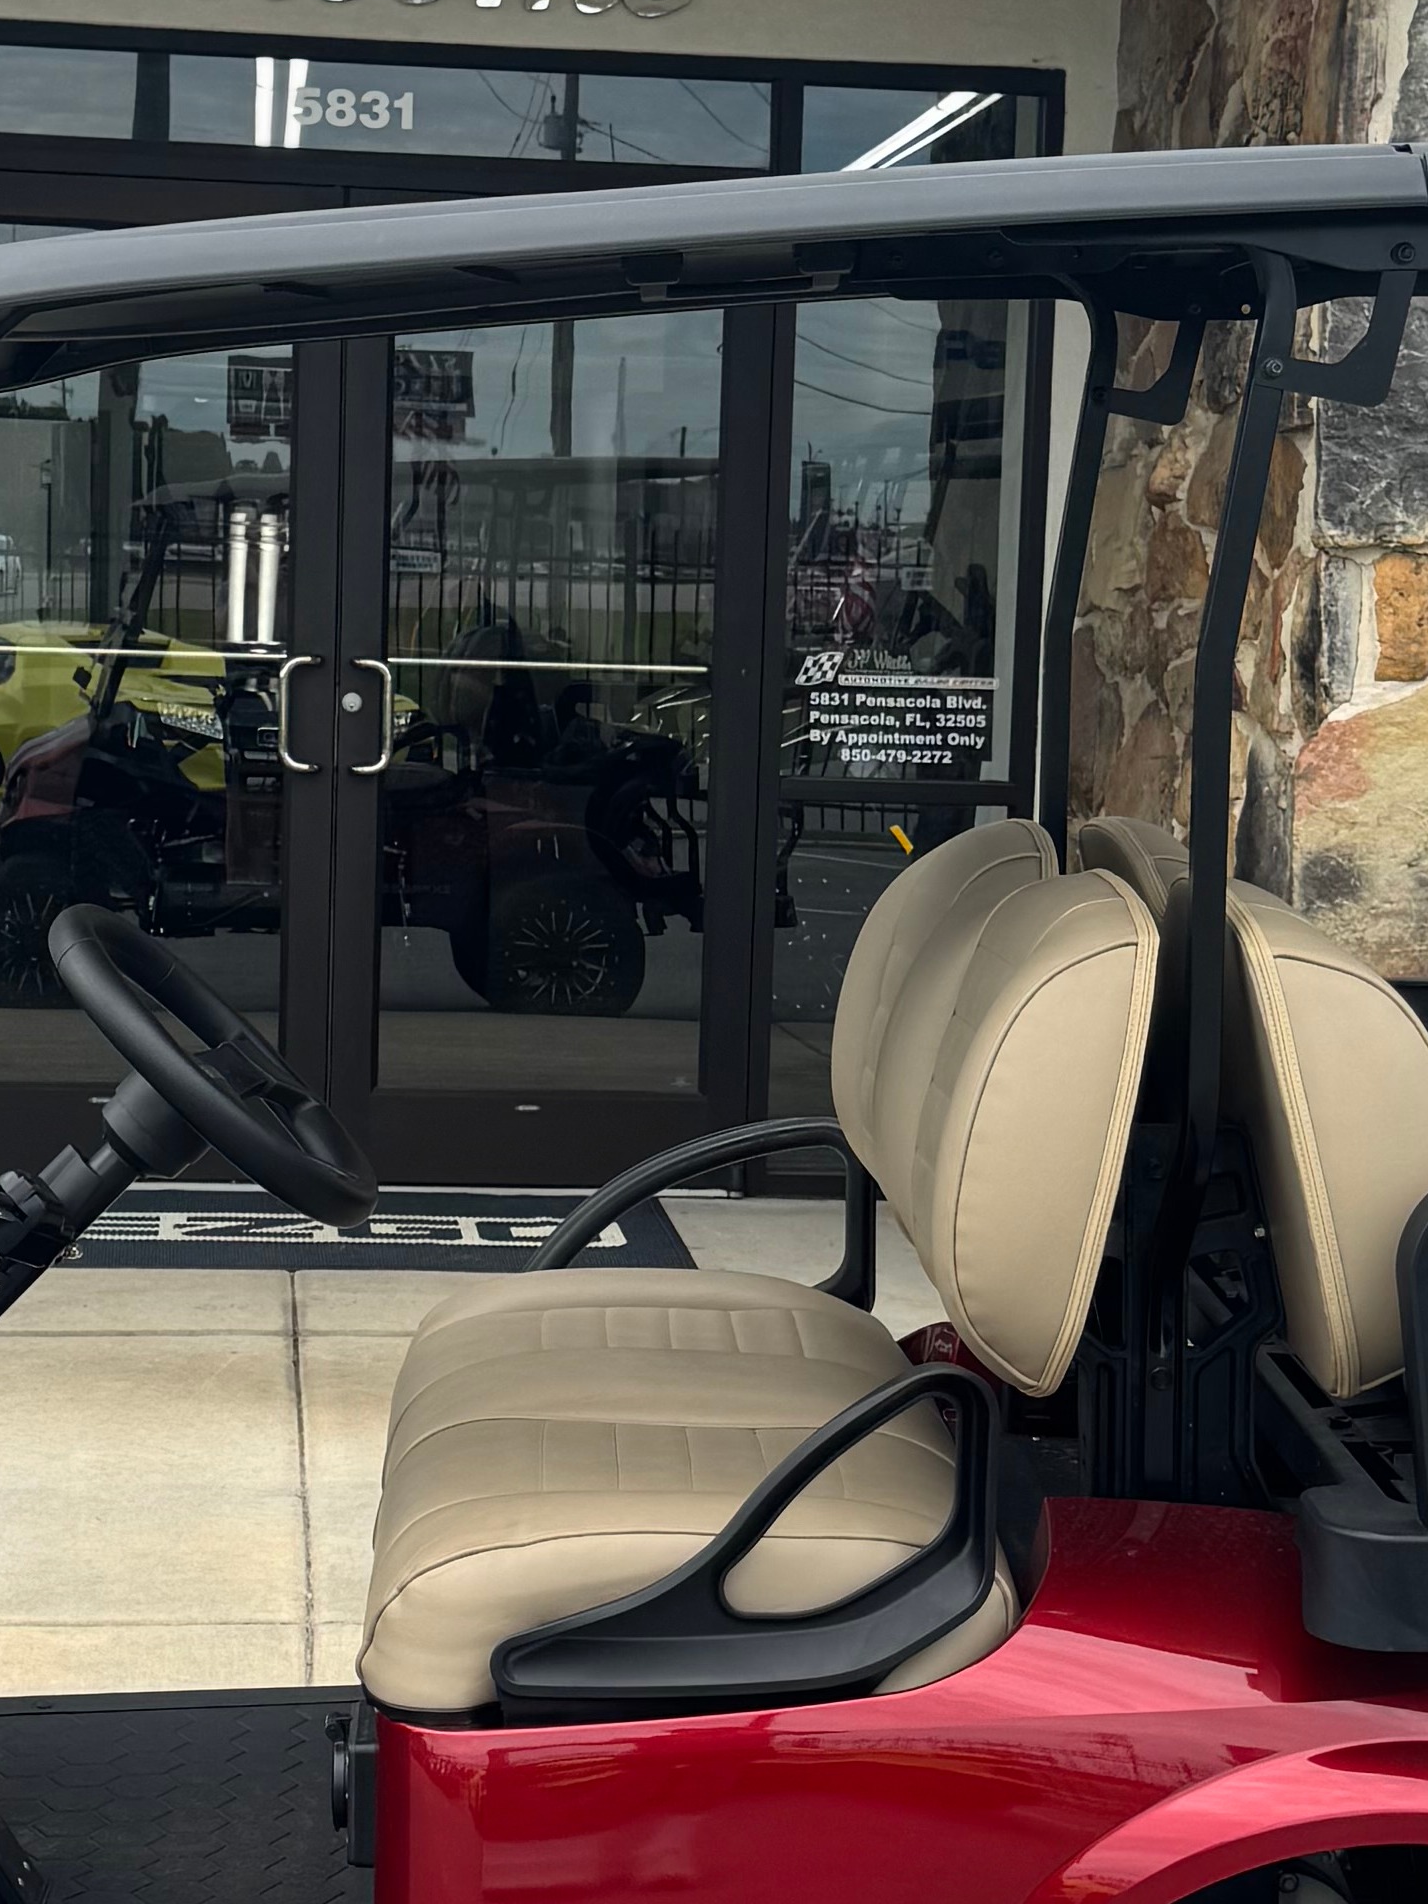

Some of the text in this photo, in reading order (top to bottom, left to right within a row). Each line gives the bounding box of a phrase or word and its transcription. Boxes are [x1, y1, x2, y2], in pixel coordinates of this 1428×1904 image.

[293, 86, 415, 130] 5831
[810, 692, 987, 710] 5831 Pensacola Blvd.
[809, 710, 986, 728] Pensacola, FL, 32505
[809, 729, 985, 749] By Appointment Only
[841, 749, 952, 764] 850-479-2272
